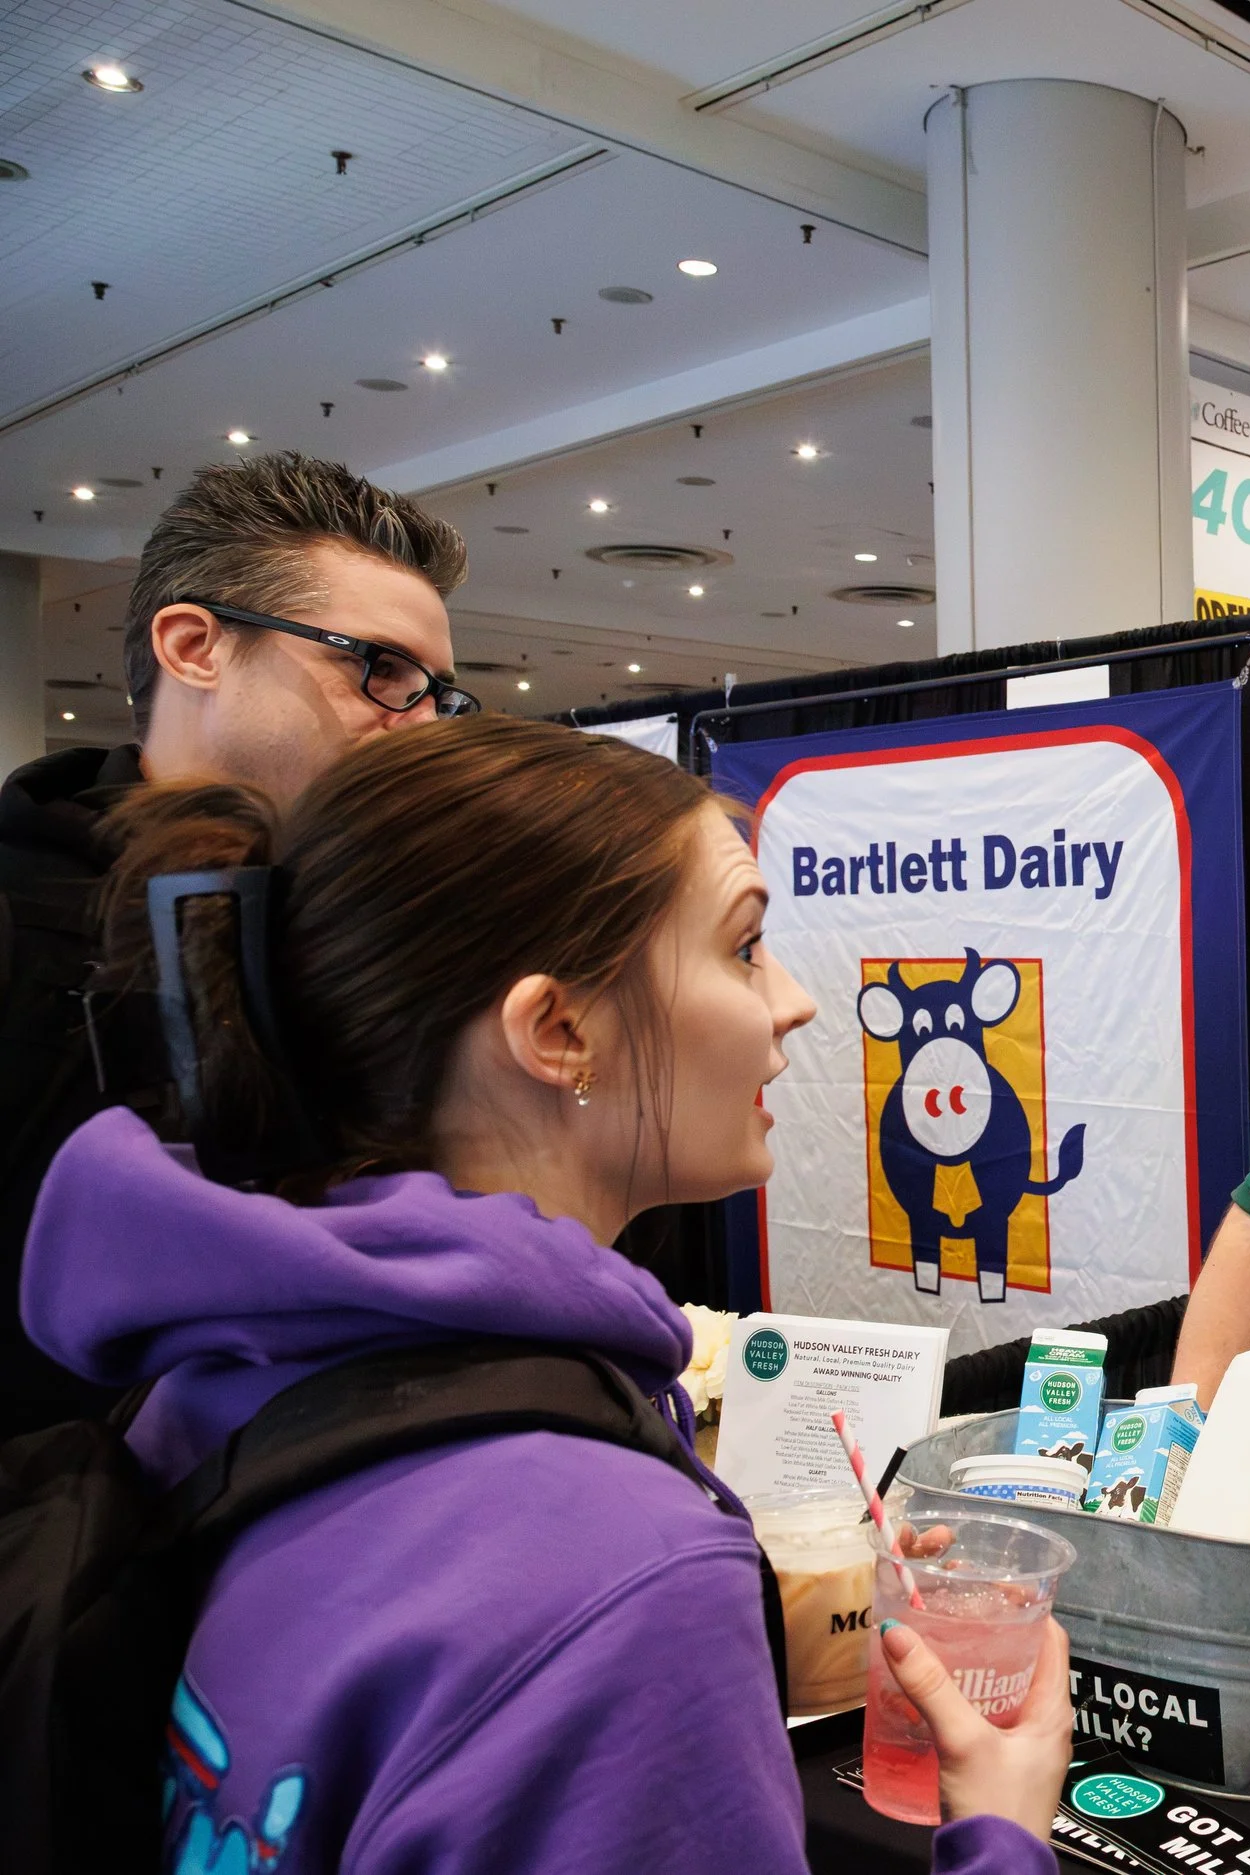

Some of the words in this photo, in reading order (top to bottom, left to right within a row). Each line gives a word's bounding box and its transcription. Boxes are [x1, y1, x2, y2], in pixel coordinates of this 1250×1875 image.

[793, 837, 967, 897] Bartlett
[982, 828, 1124, 900] Dairy
[751, 1340, 784, 1349] HUDSON
[794, 1341, 830, 1352] HUDSON
[832, 1345, 863, 1355] VALLEY
[865, 1347, 890, 1357] FRESH
[892, 1350, 920, 1360] DAIRY
[750, 1350, 784, 1360] VALLEY
[752, 1361, 779, 1371] FRESH
[843, 1358, 871, 1366] Premium
[872, 1360, 895, 1370] Quality
[896, 1363, 915, 1372] Dairy
[813, 1367, 839, 1376] AWARD
[840, 1370, 872, 1380] WINNING
[873, 1373, 902, 1382] QUALITY
[1048, 1381, 1076, 1389] HUDSON
[1046, 1389, 1076, 1397] VALLEY
[1117, 1430, 1141, 1438] VALLEY
[1118, 1438, 1136, 1446] FRESH
[1017, 1491, 1047, 1499] Nutrition
[1095, 1680, 1208, 1729] LOCAL
[1095, 1782, 1143, 1811] VALLEY
[1109, 1778, 1152, 1804] HUDSON
[1083, 1791, 1122, 1815] FRESH
[1166, 1805, 1244, 1846] GOT
[1158, 1836, 1246, 1875] MIL
